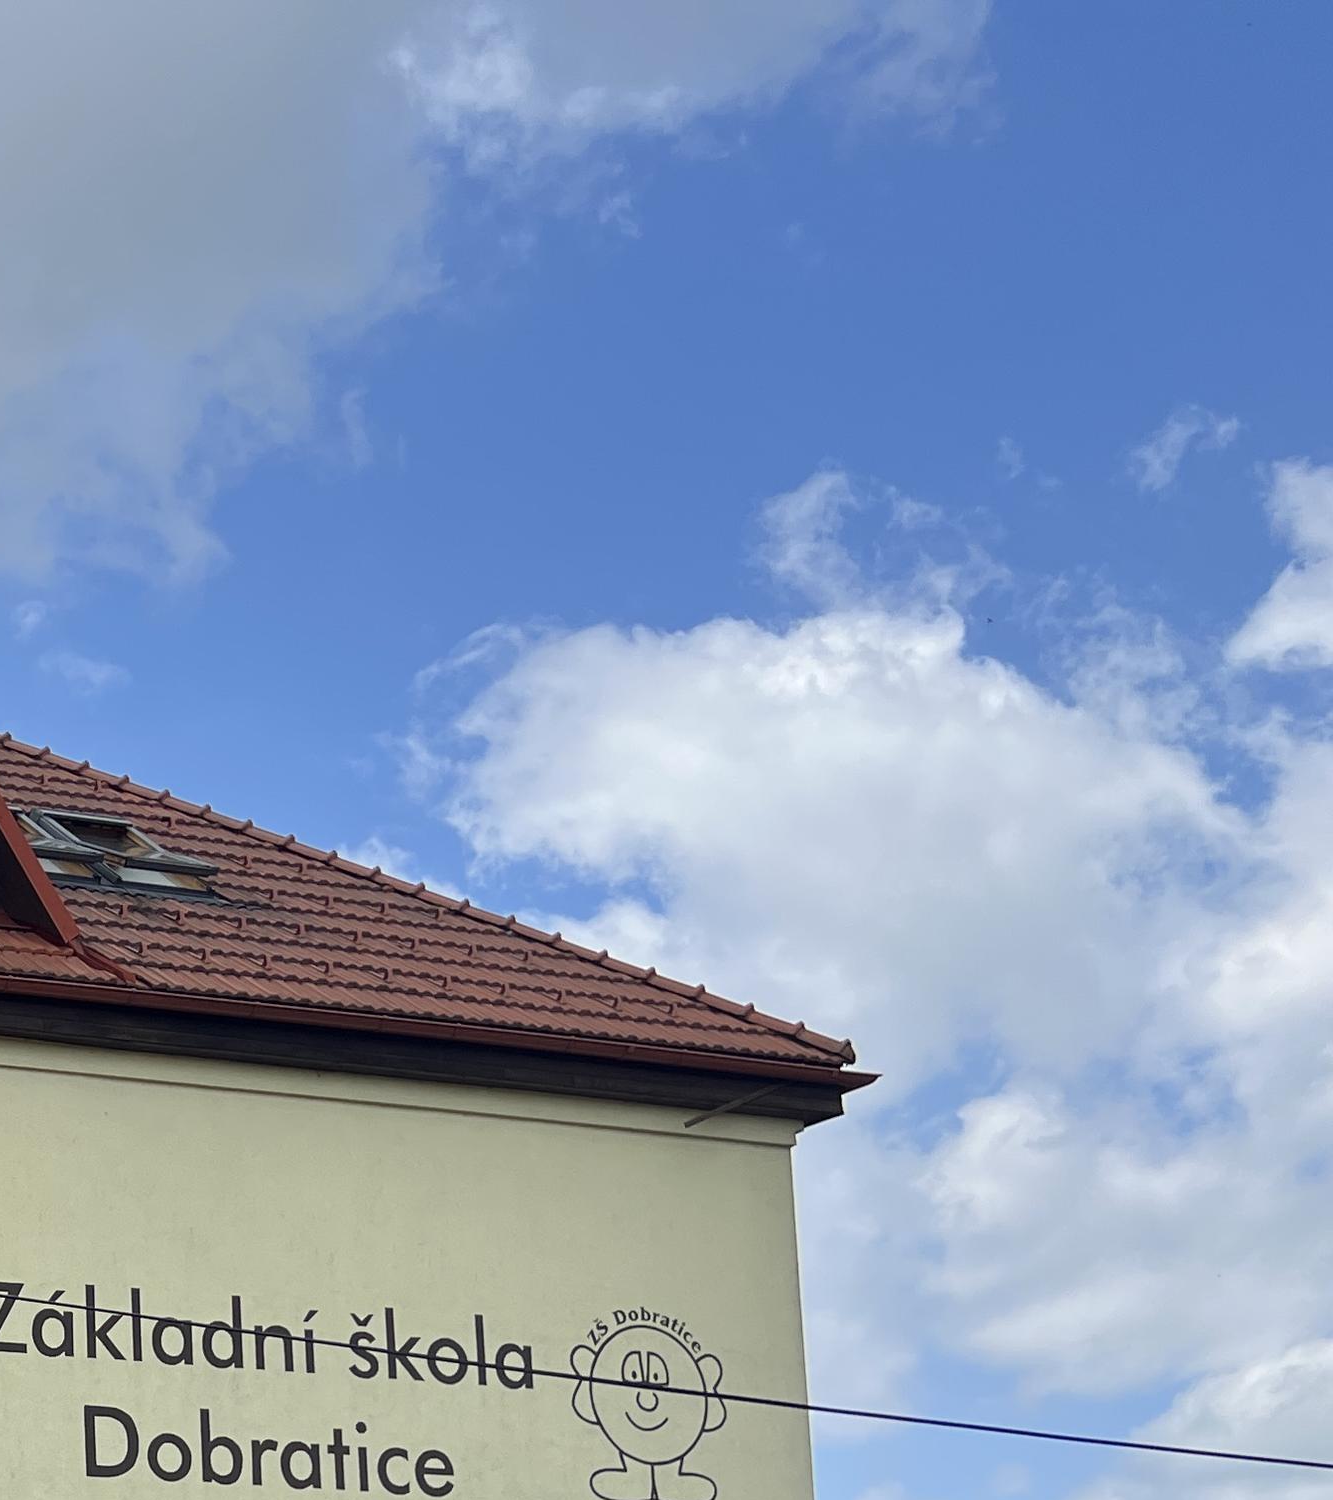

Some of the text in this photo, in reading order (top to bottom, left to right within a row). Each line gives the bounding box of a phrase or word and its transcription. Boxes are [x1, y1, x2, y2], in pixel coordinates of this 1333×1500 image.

[348, 1308, 535, 1390] škola
[587, 1307, 702, 1353] ZŠ Dobratice
[84, 1405, 456, 1498] Dobratice
